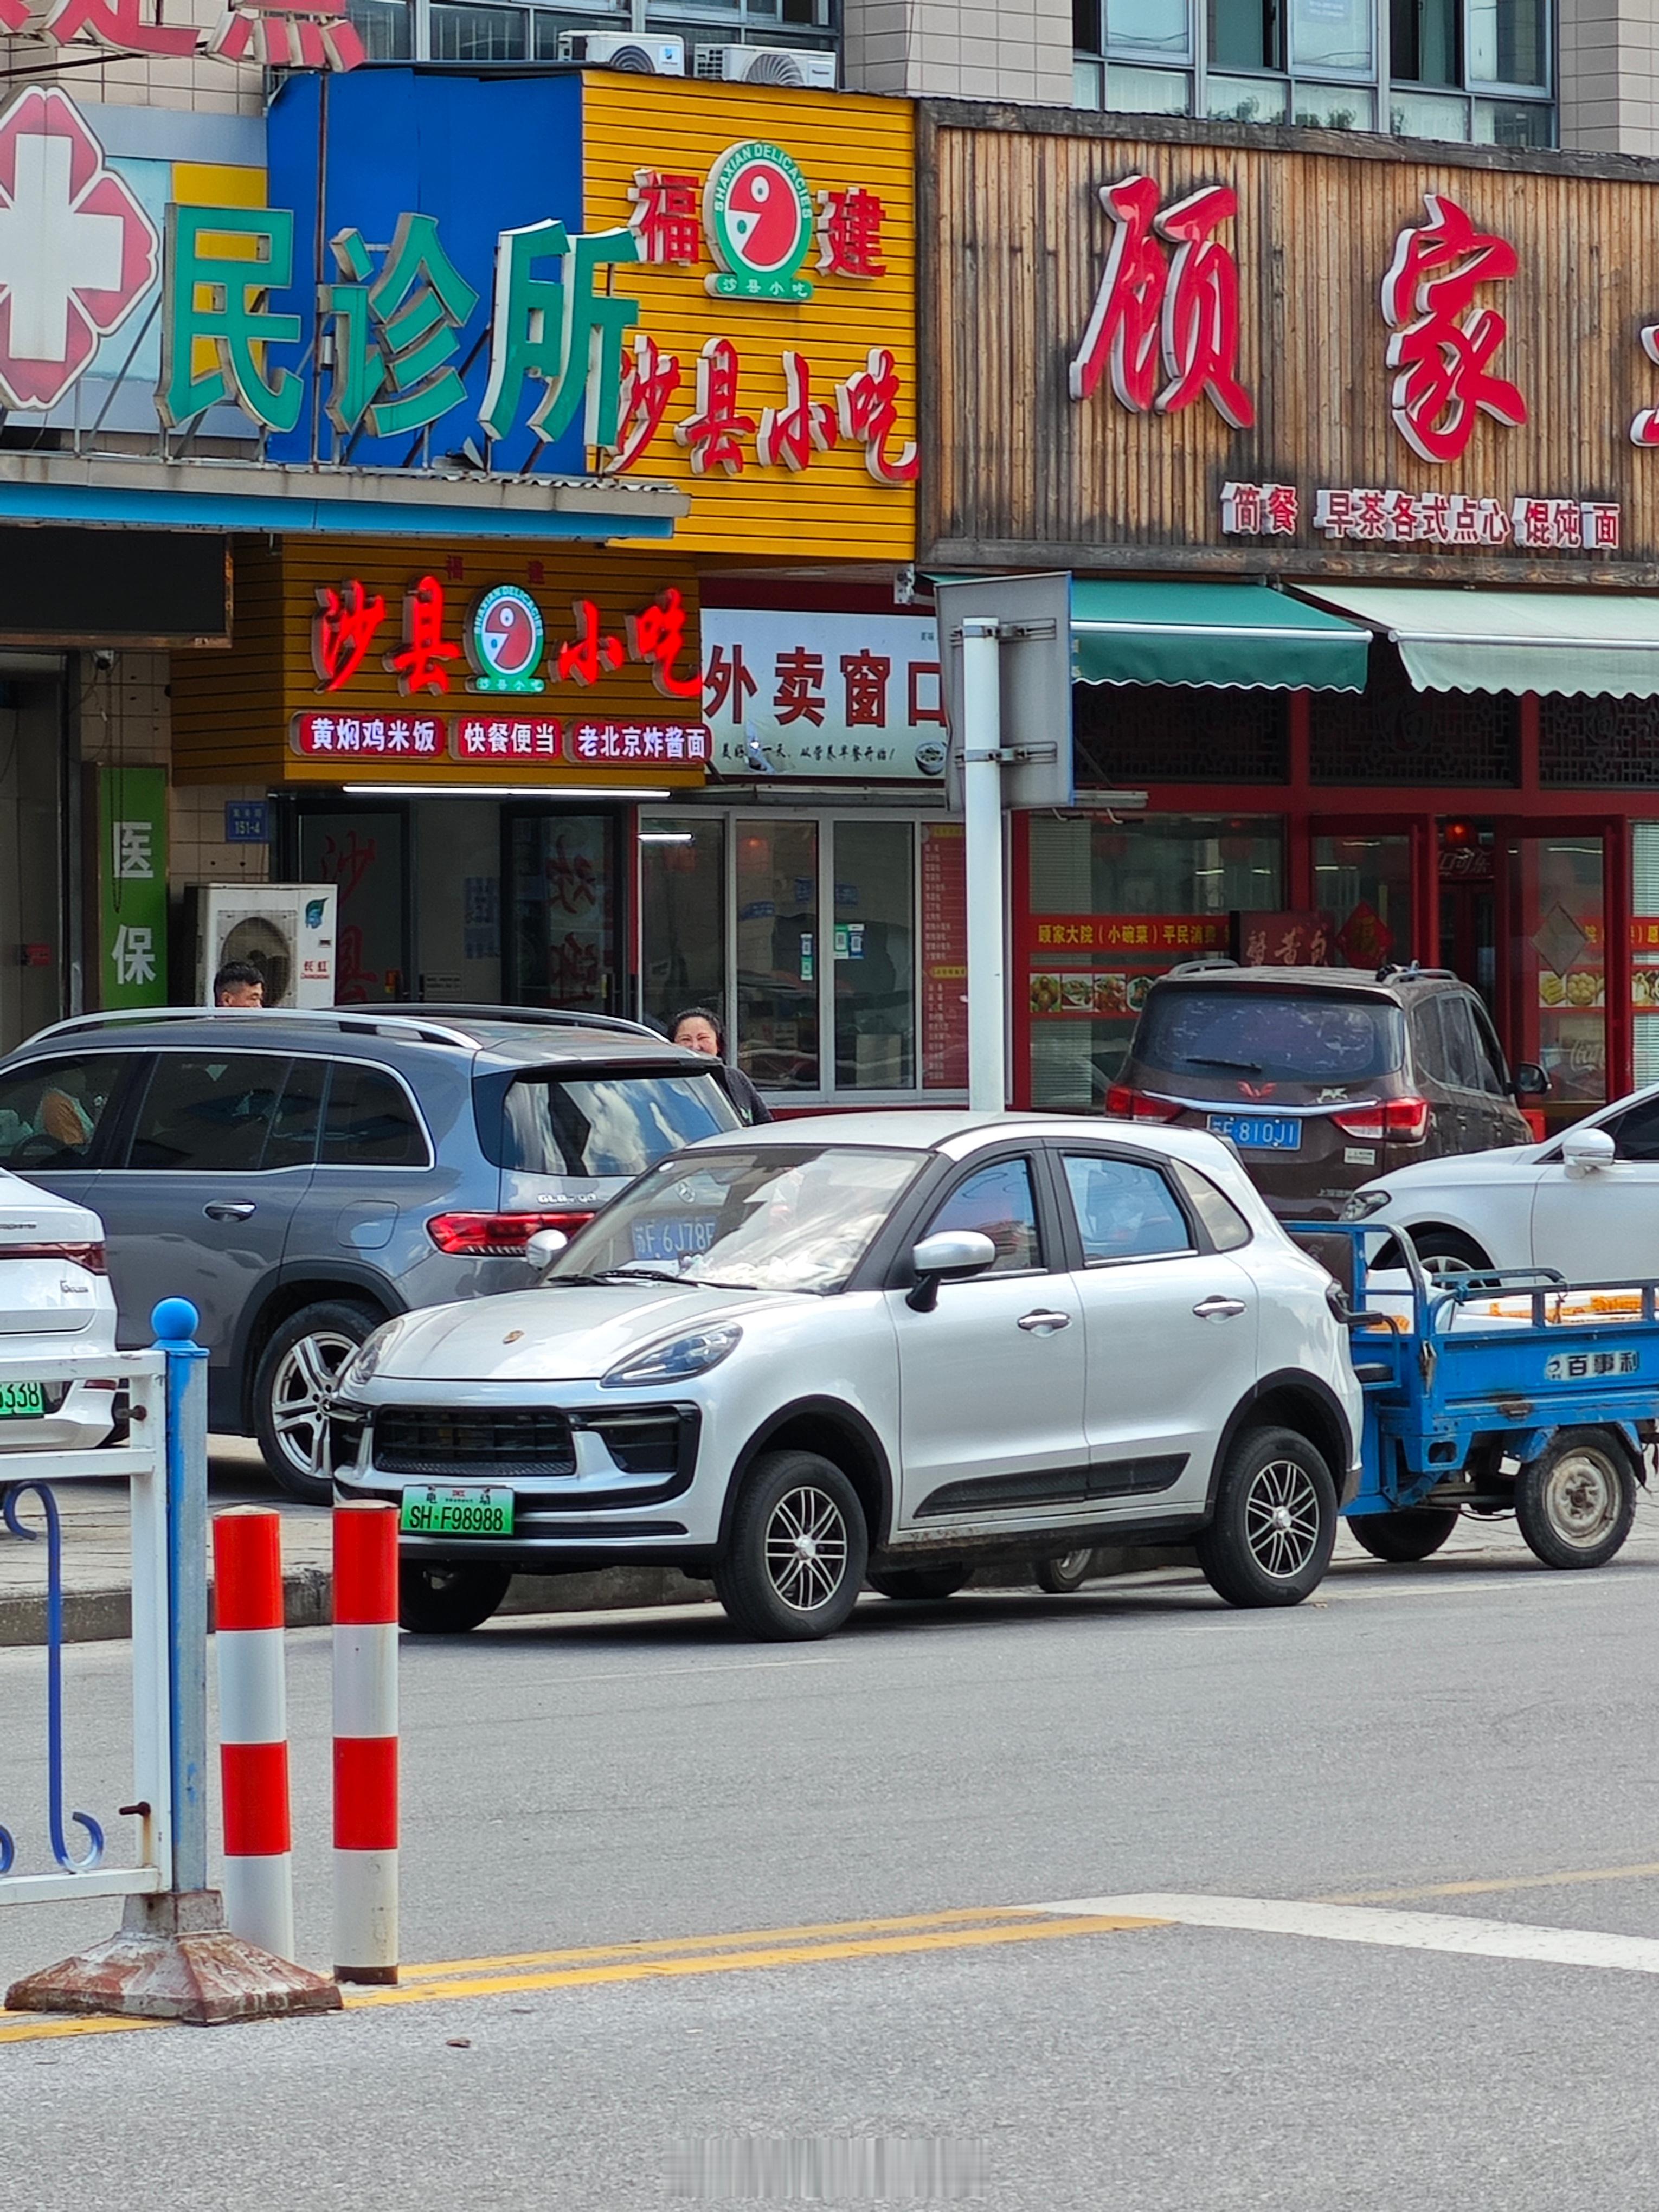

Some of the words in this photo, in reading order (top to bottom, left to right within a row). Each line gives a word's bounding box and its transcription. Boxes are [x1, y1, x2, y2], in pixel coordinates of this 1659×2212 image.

[713, 146, 753, 214] SHAXIAN
[754, 142, 813, 221] DELICACIES
[627, 168, 699, 266] 福
[816, 186, 887, 279] 建
[154, 202, 641, 447] 民诊所
[722, 278, 808, 299] 沙县小吃
[1070, 175, 1659, 462] 顾家
[604, 335, 920, 484] 沙县小吃
[1220, 483, 1297, 536] 简餐
[1315, 488, 1509, 545] 早茶各式点心
[1512, 497, 1620, 549] 馄饨面
[703, 644, 947, 728] 外卖窗口
[310, 718, 437, 753] 黄焖鸡米饭
[464, 723, 555, 755] 快餐便当
[577, 725, 707, 760] 老北京炸酱面
[235, 821, 260, 834] 151-4
[111, 821, 157, 985] 医保
[0, 1383, 40, 1408] 338
[1568, 1351, 1639, 1376] 百事利
[409, 1505, 504, 1532] SH·F98988
